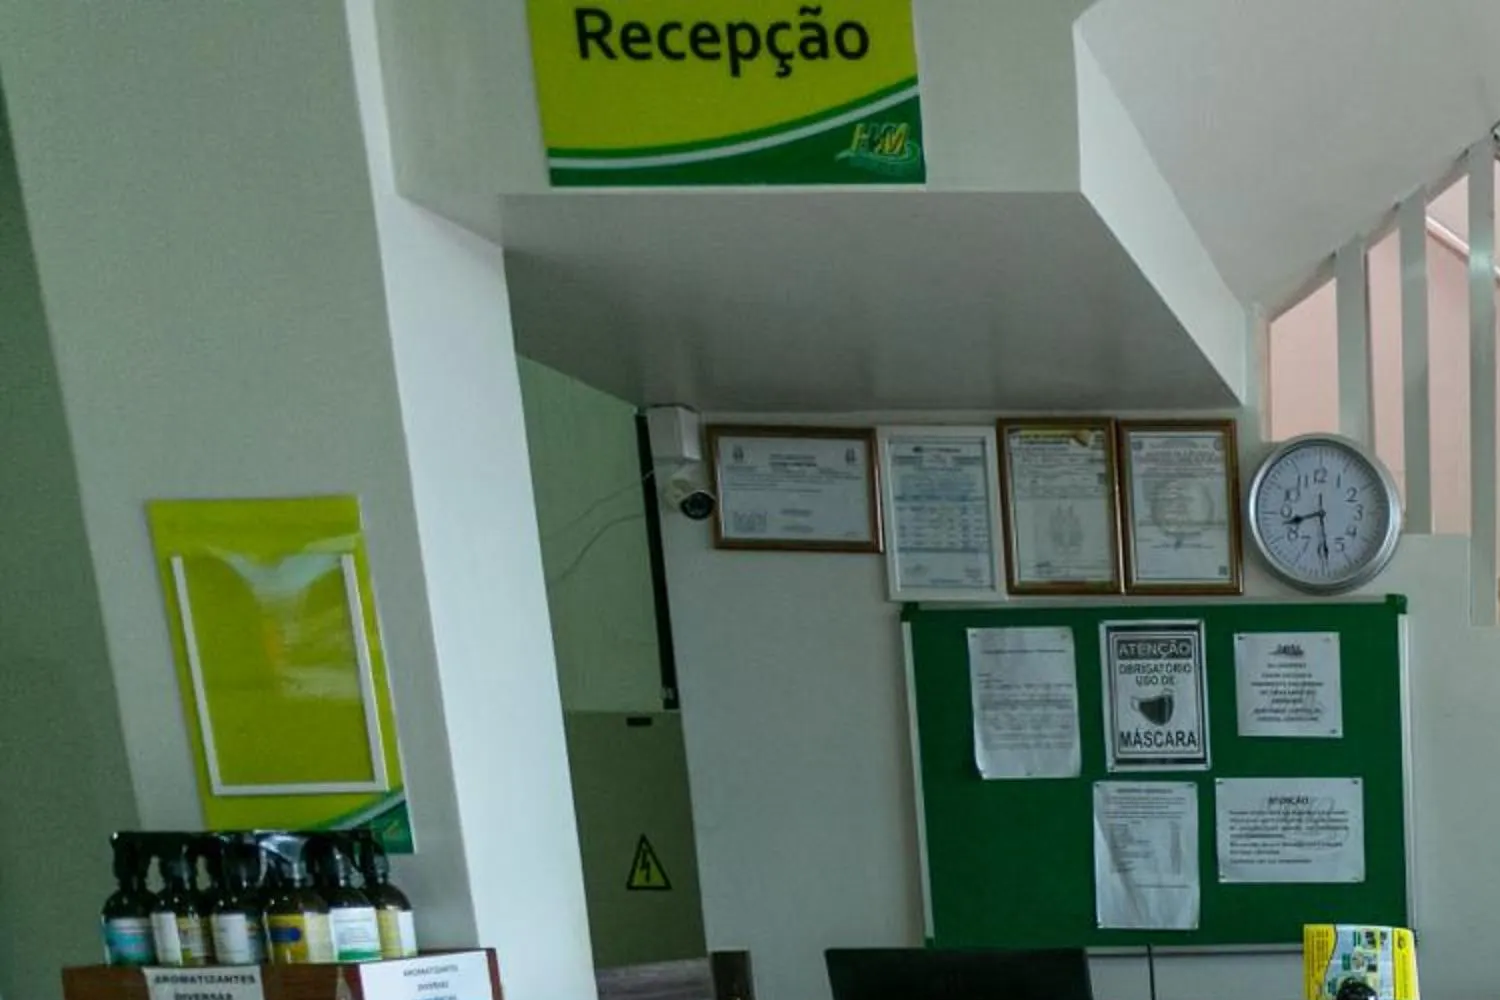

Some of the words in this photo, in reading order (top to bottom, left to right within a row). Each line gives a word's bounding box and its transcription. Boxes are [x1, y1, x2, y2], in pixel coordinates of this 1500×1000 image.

[575, 6, 870, 78] Recepção
[1314, 468, 1328, 483] 12
[1345, 487, 1358, 502] 2
[1354, 504, 1364, 521] 3
[1287, 526, 1299, 542] 8
[1335, 537, 1345, 552] 5
[1118, 640, 1193, 660] ATENÇÃO
[1118, 661, 1193, 675] OBRIGATÓRIO
[1135, 675, 1159, 687] USO
[1161, 674, 1175, 686] DE
[1119, 727, 1198, 749] MÁSCARA
[154, 974, 256, 985] AROMATIZANTES
